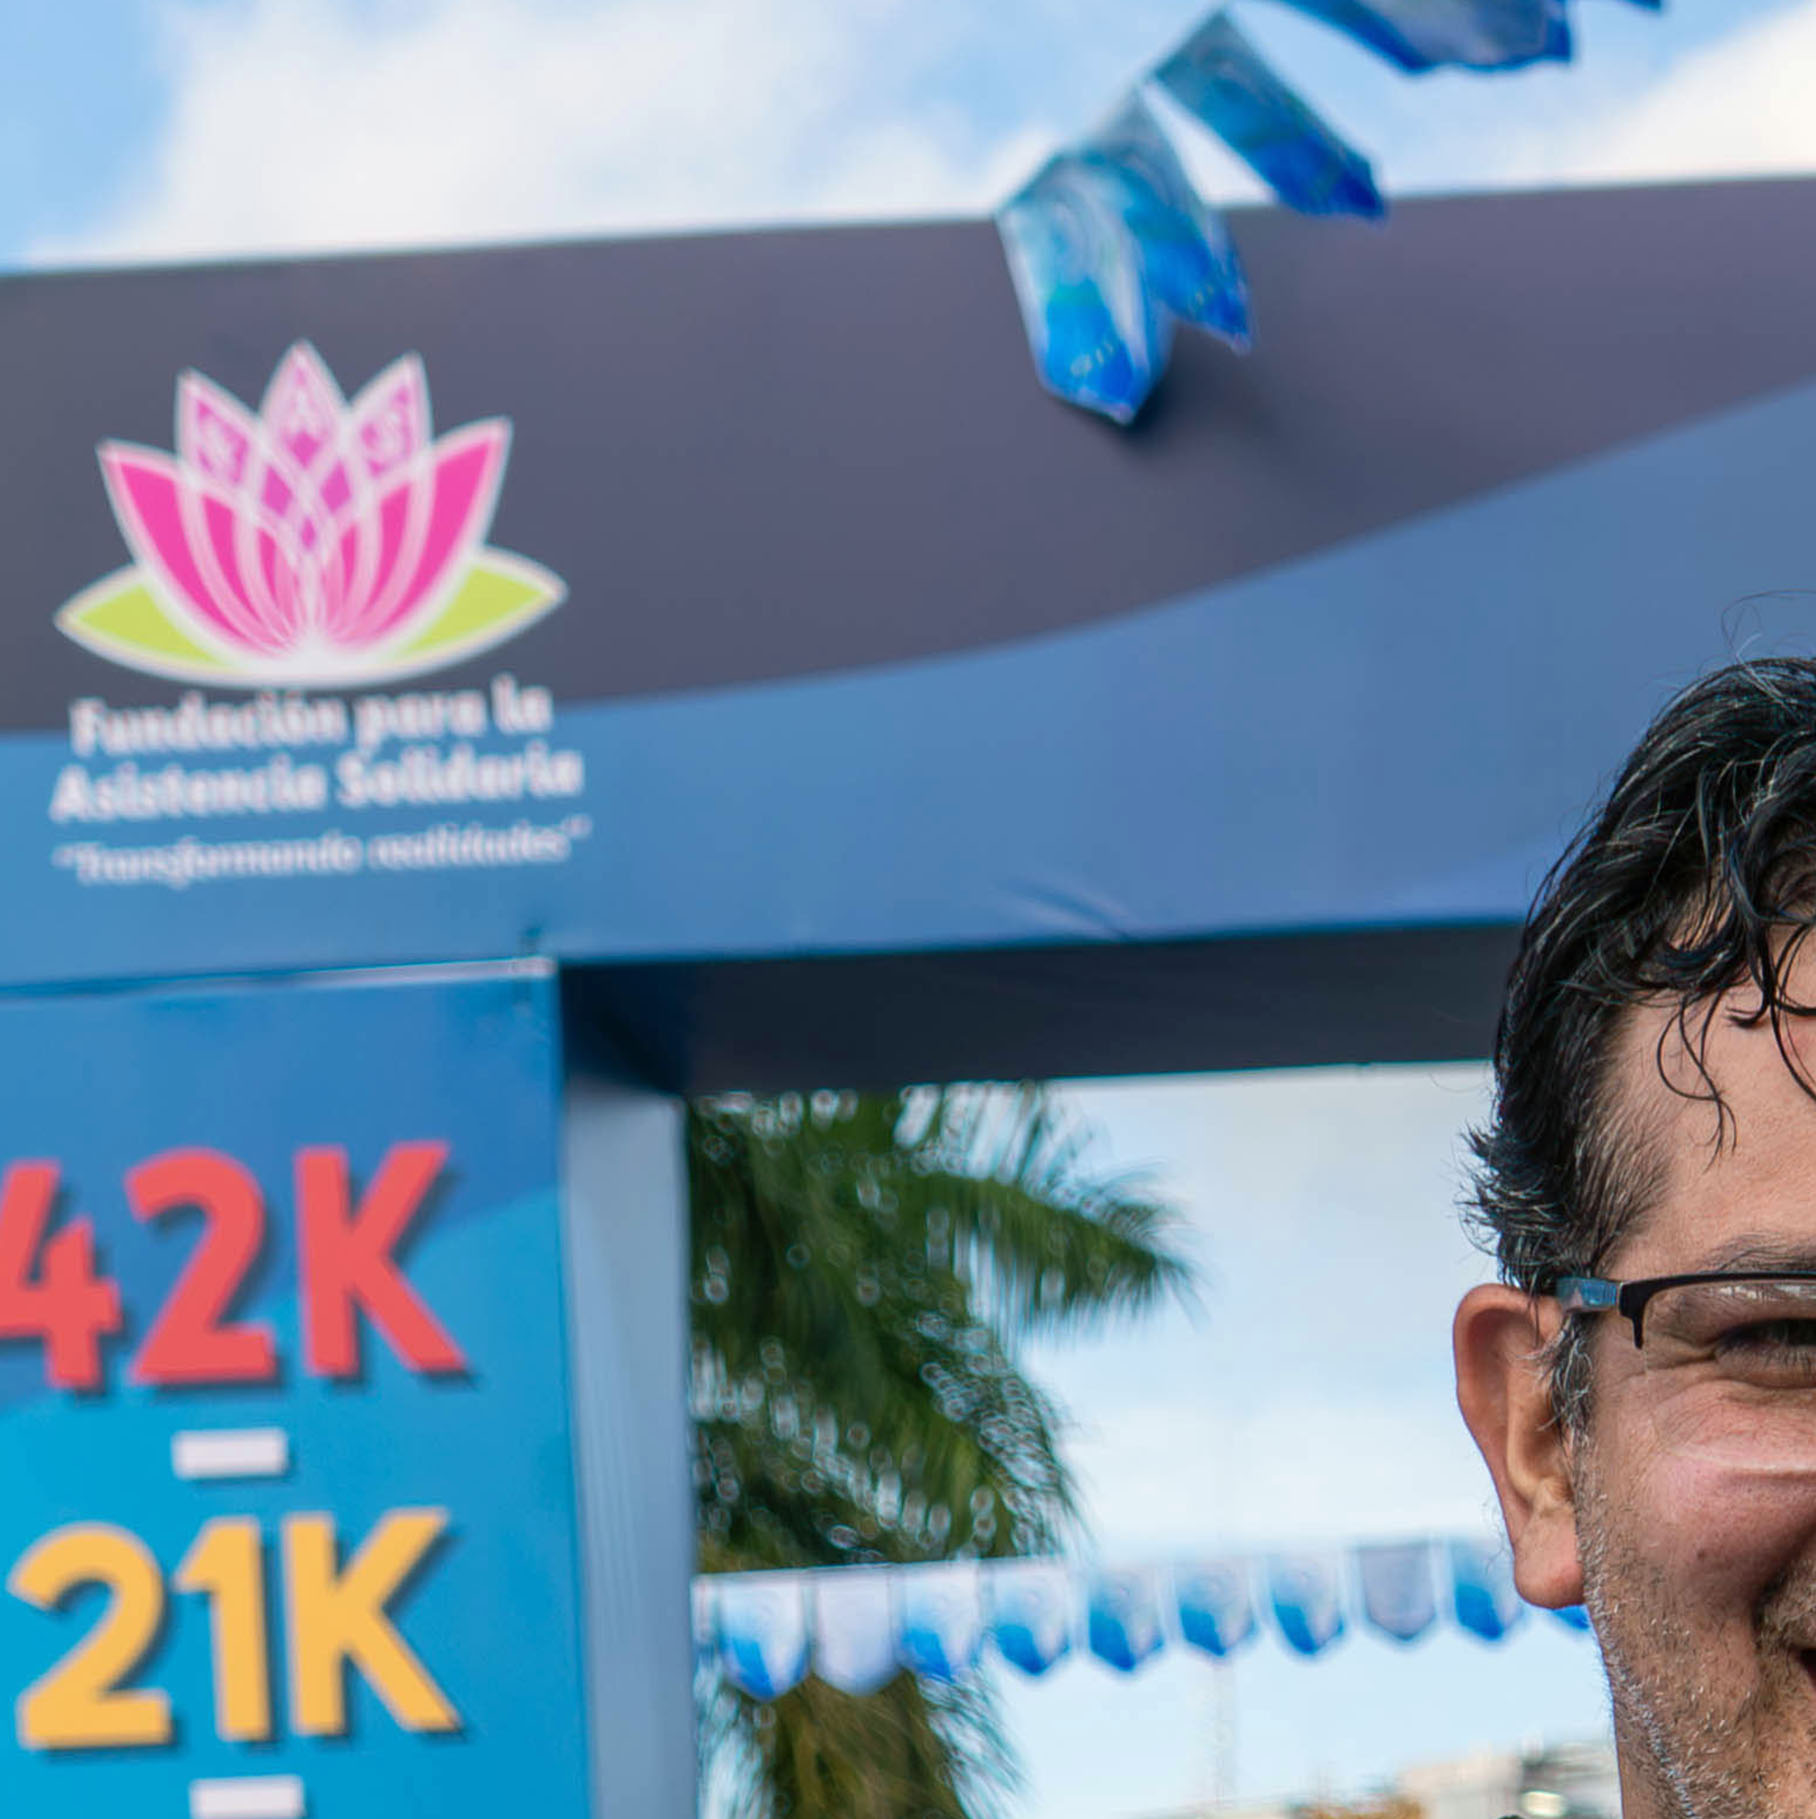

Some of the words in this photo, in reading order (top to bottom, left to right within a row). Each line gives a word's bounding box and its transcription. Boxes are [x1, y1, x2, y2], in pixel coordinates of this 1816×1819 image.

[50, 755, 328, 822] Asistencia
[335, 741, 586, 808] Solidaria
[355, 690, 487, 751] para
[491, 672, 553, 735] la
[0, 1140, 470, 1390] 42K
[7, 1507, 464, 1750] 21K
